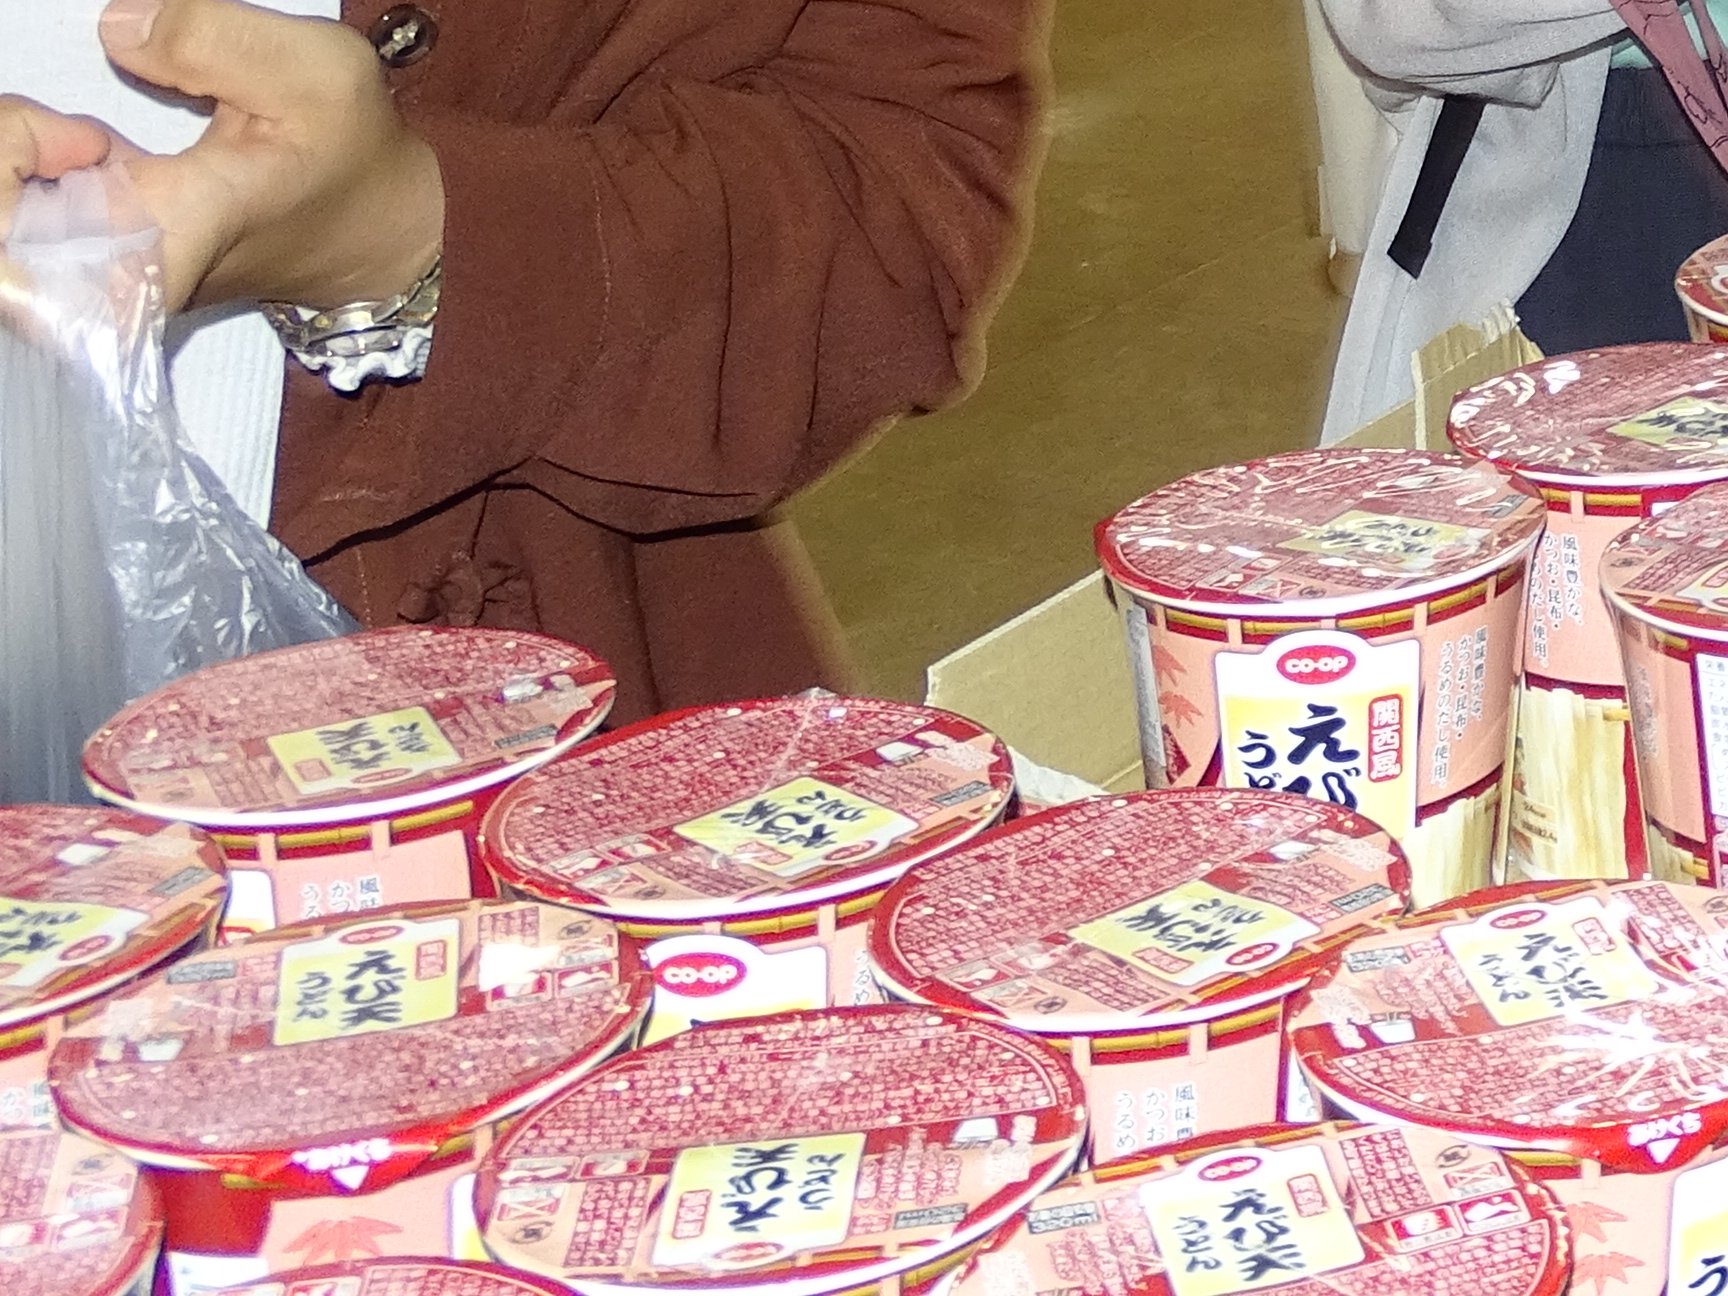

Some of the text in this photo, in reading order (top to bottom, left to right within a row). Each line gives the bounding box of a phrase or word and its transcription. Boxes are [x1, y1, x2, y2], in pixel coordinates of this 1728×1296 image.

[1373, 696, 1401, 779] 関西風
[340, 950, 403, 1028] えび天
[1217, 1188, 1308, 1279] えび天
